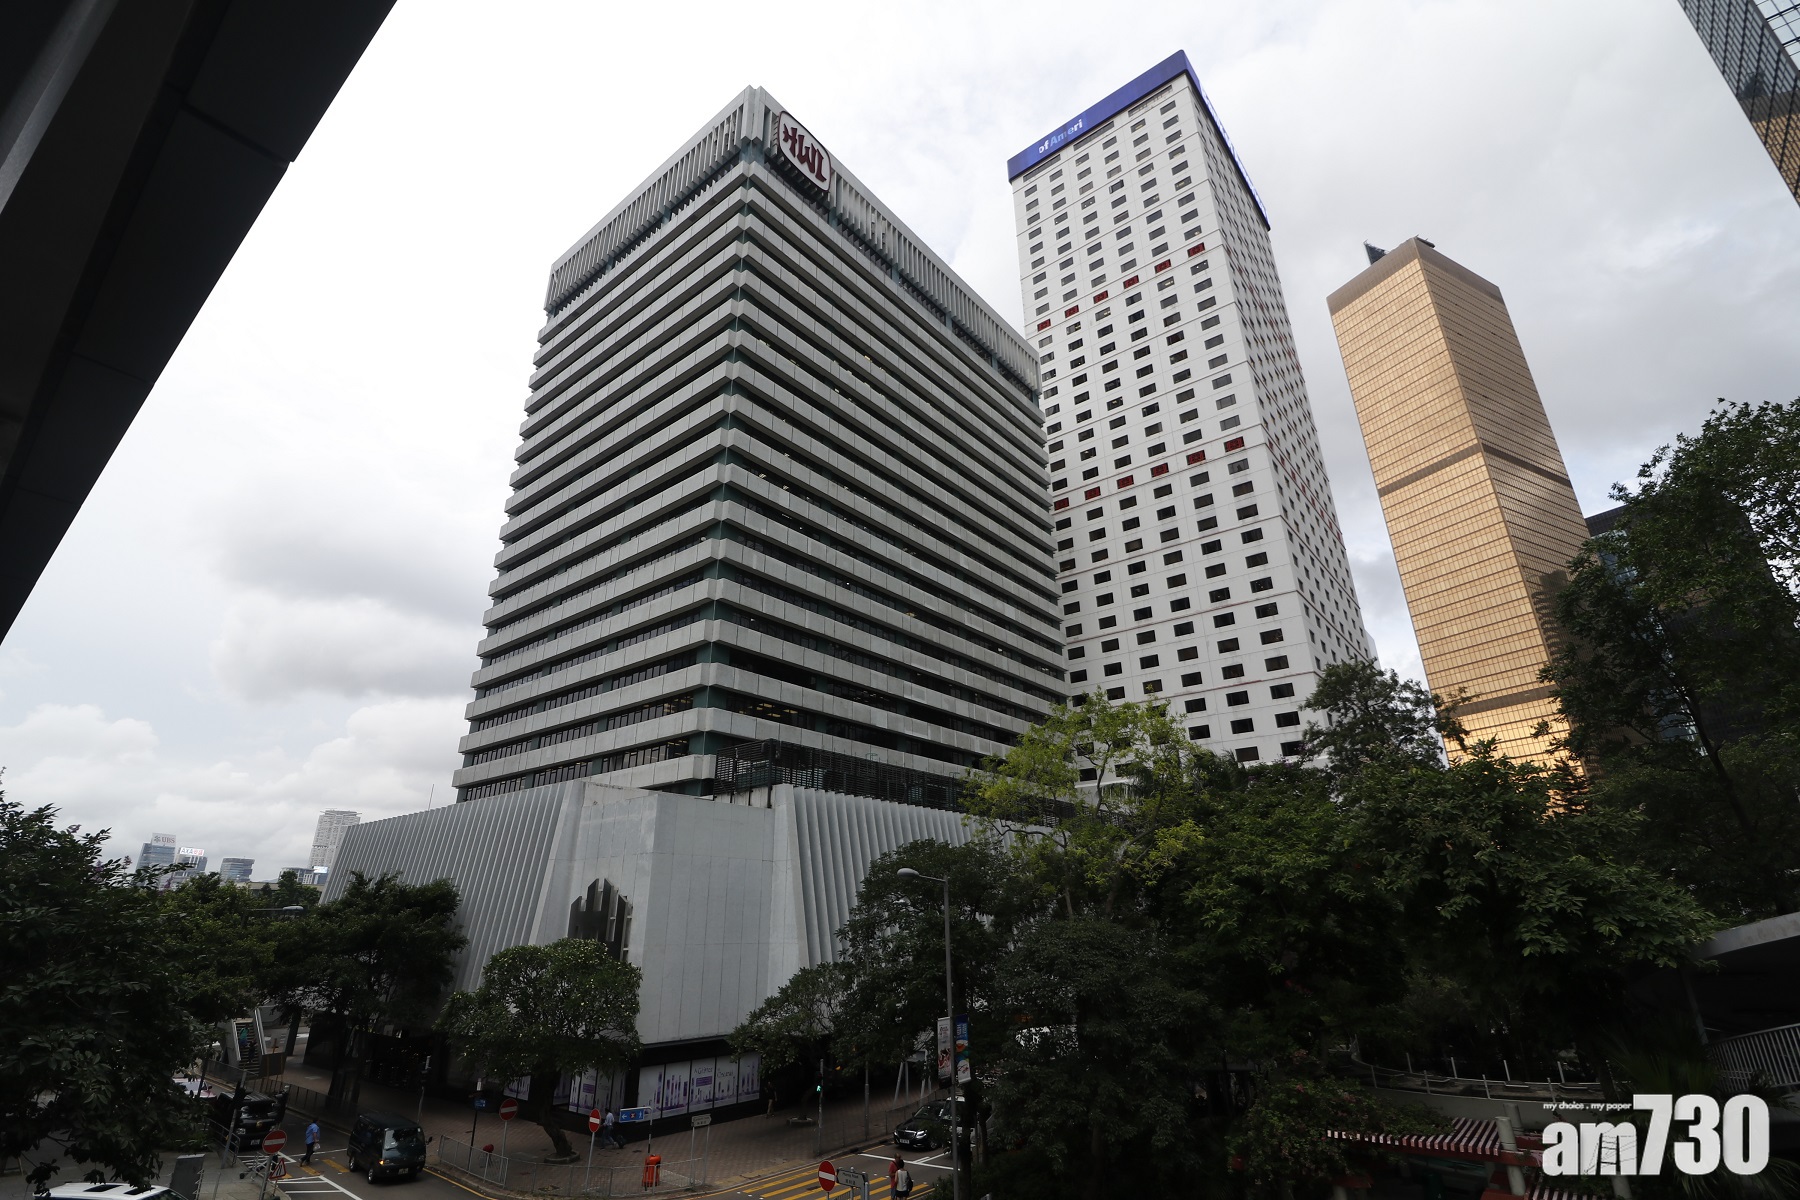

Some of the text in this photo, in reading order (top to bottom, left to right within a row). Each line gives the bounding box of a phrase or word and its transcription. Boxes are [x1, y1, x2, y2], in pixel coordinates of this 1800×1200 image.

[783, 123, 827, 182] HWL
[1038, 139, 1049, 154] of
[161, 836, 175, 844] UBS
